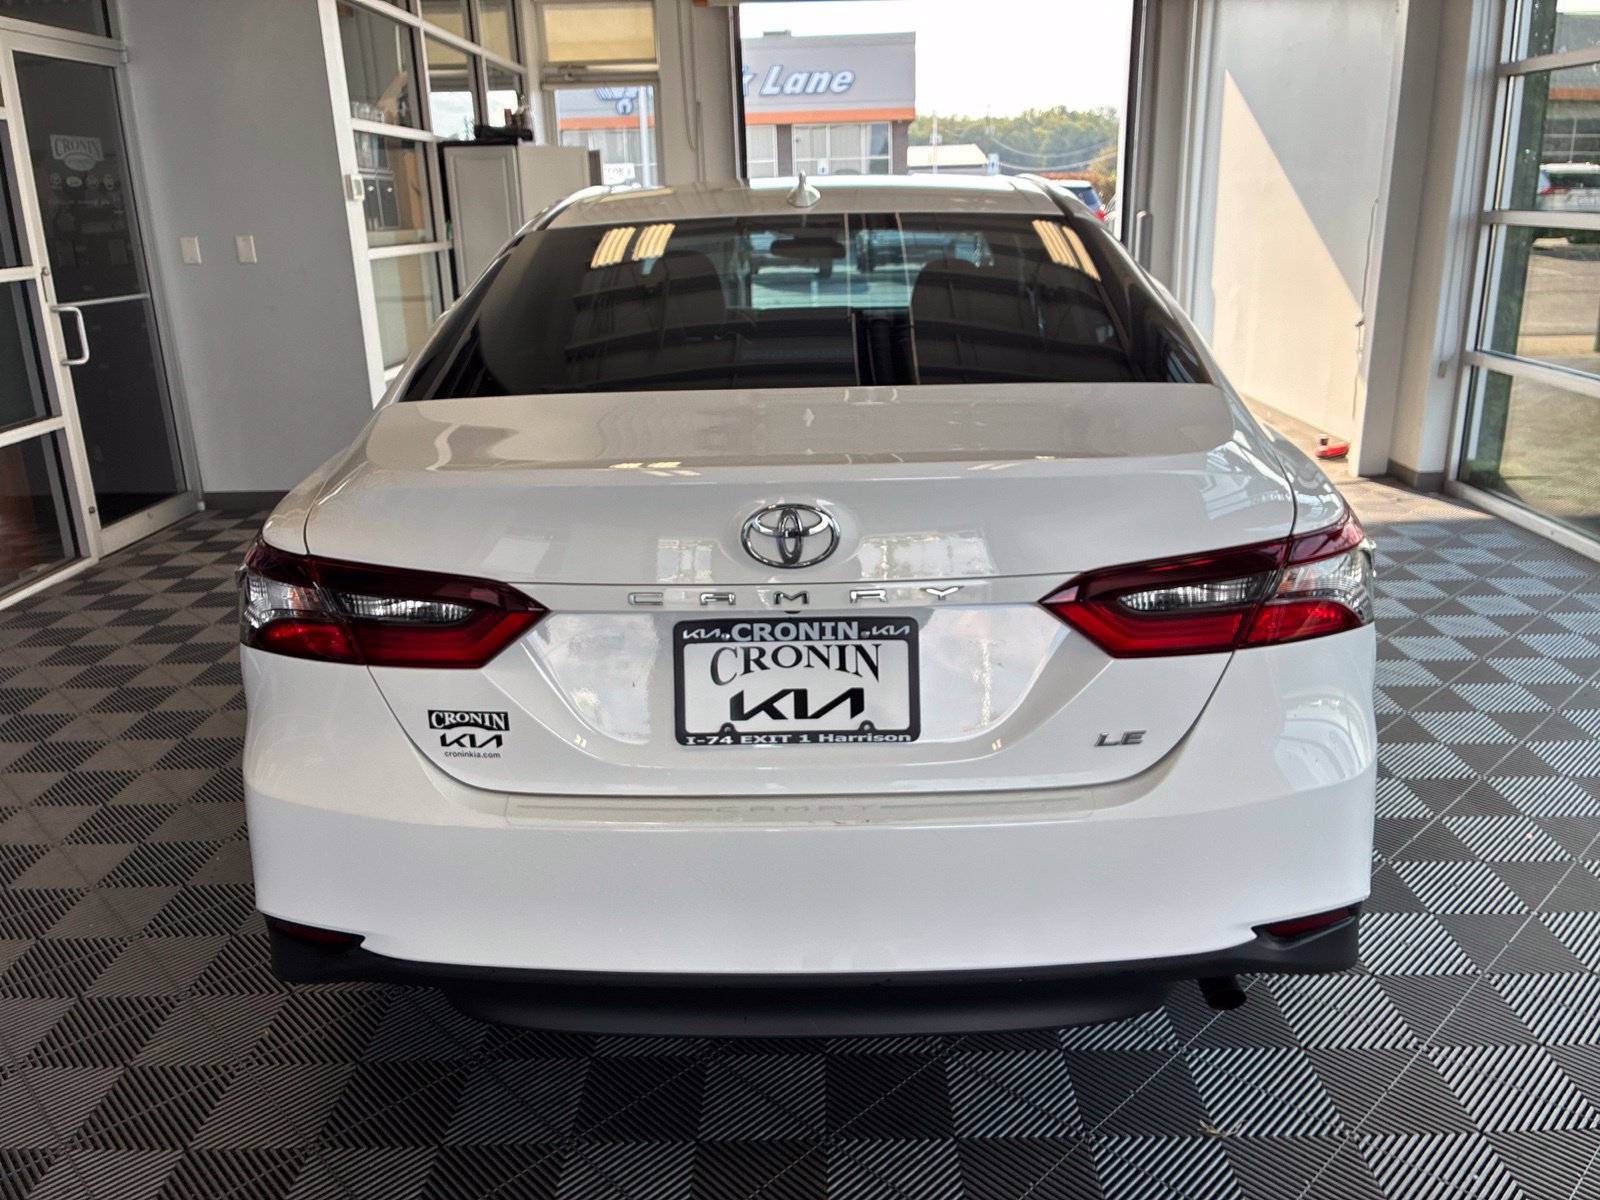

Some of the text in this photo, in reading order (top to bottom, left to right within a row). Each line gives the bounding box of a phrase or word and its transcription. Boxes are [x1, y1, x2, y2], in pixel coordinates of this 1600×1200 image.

[759, 64, 855, 96] Lane
[54, 138, 102, 160] CRONIN
[628, 585, 964, 606] CAMRY
[683, 621, 910, 642] KIA CRONIN KIA
[710, 643, 882, 686] CRONIN
[729, 687, 865, 721] KIA
[431, 711, 506, 730] CRONIN
[440, 733, 503, 749] KIA
[686, 733, 912, 745] I-74 EXIT 1 Harrison
[1094, 730, 1147, 747] LE
[444, 750, 502, 759] croninkia.com
